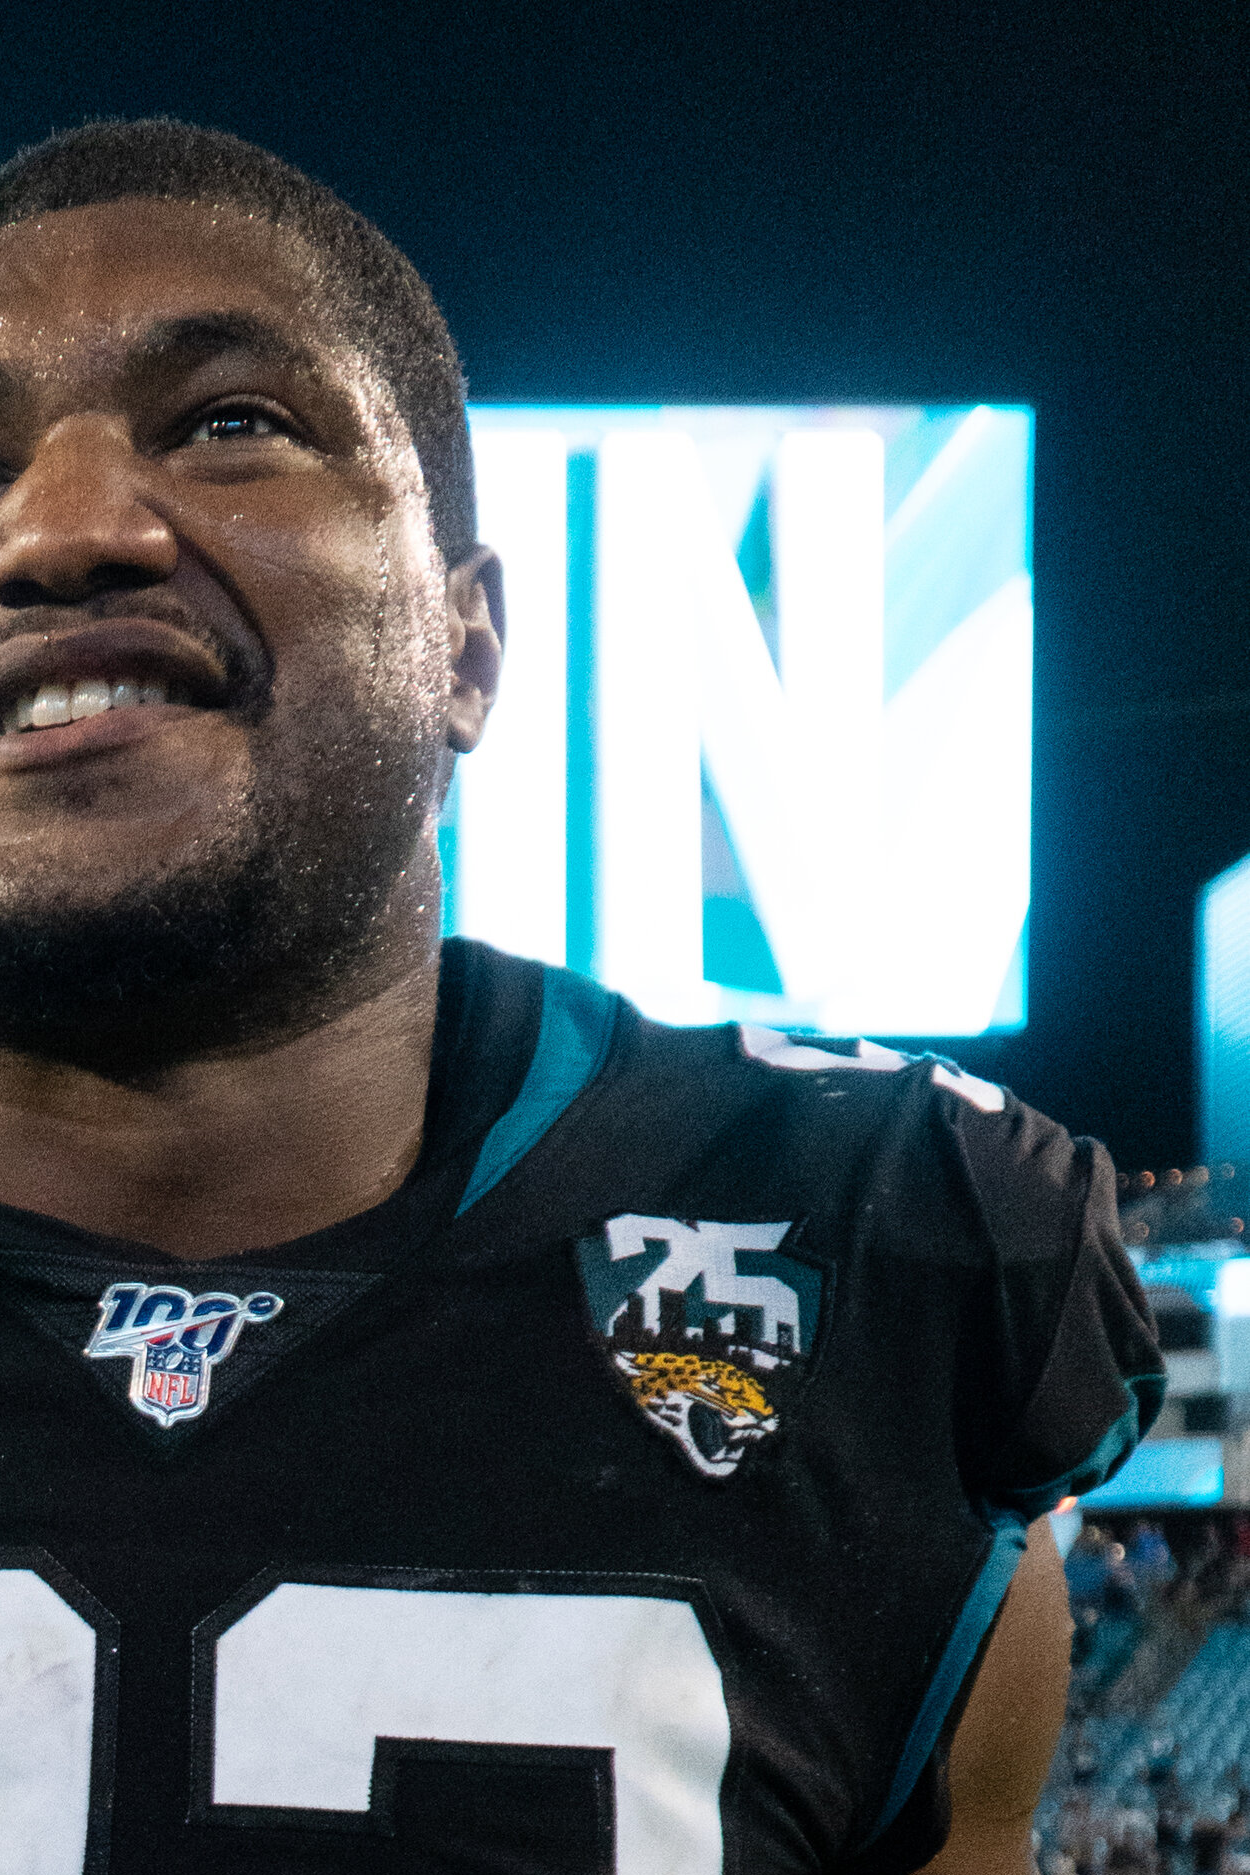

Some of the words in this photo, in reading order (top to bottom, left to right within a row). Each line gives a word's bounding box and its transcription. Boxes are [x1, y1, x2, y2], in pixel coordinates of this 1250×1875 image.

[97, 1283, 244, 1361] 100
[605, 1213, 801, 1353] 25
[147, 1371, 195, 1406] NFL
